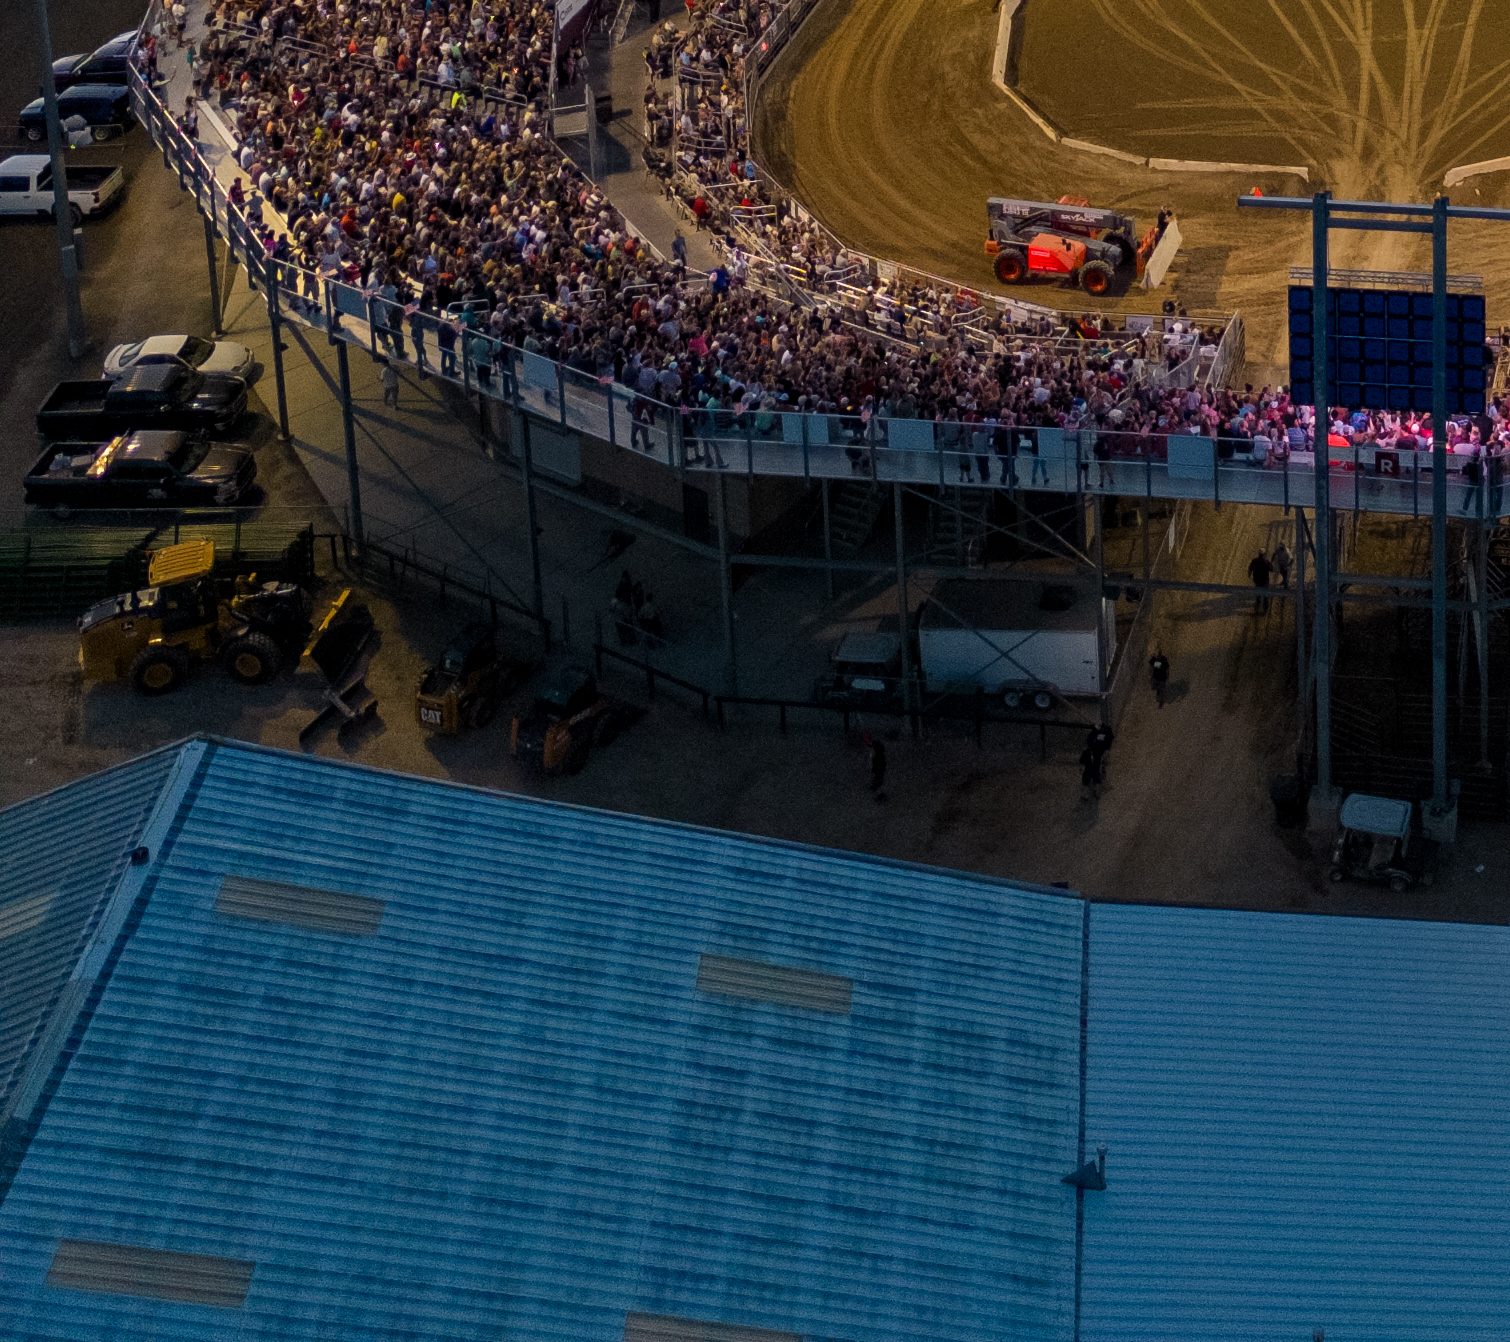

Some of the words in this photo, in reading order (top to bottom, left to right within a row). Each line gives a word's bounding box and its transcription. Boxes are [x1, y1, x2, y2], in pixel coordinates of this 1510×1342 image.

[1060, 213, 1097, 223] SKYJACK
[640, 408, 651, 423] A
[1380, 459, 1393, 473] R
[420, 707, 442, 725] CAT
